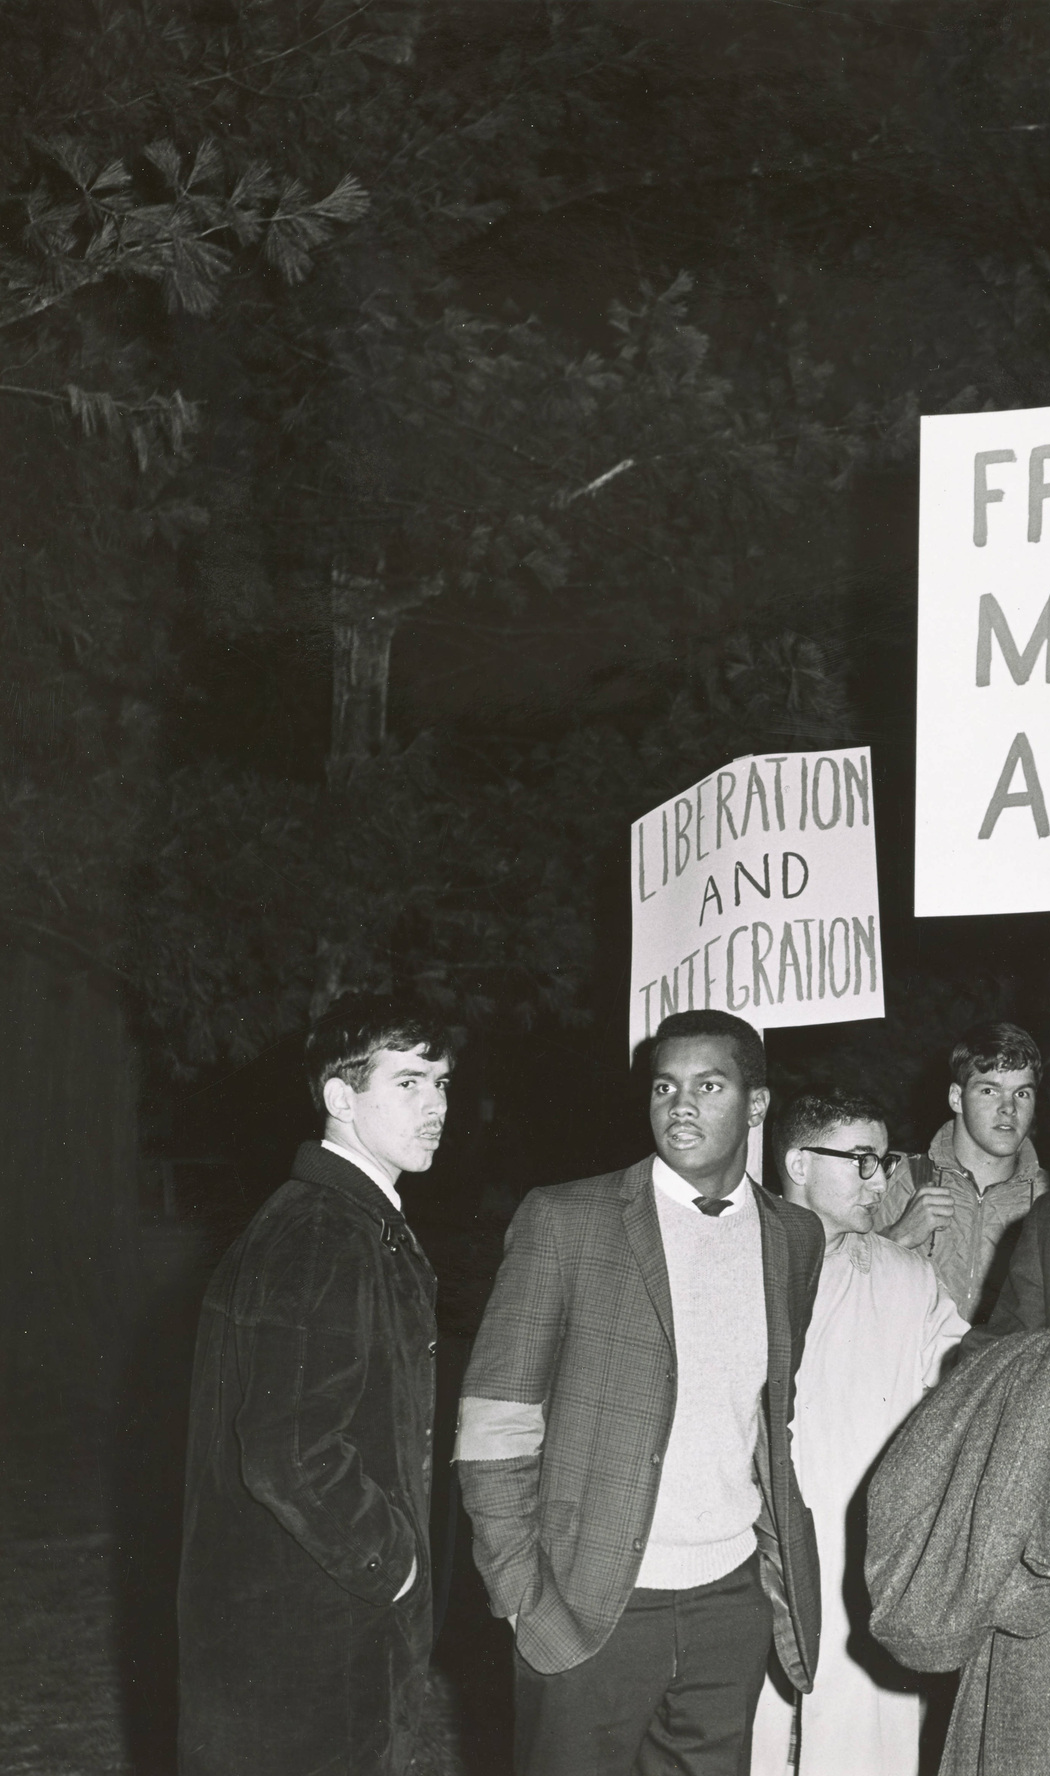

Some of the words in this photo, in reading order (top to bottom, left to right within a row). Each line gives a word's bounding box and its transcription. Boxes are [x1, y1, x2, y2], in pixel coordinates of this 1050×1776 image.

[638, 755, 870, 902] LIBERATION
[700, 852, 809, 927] AND
[639, 915, 877, 1036] INTEGRATION
